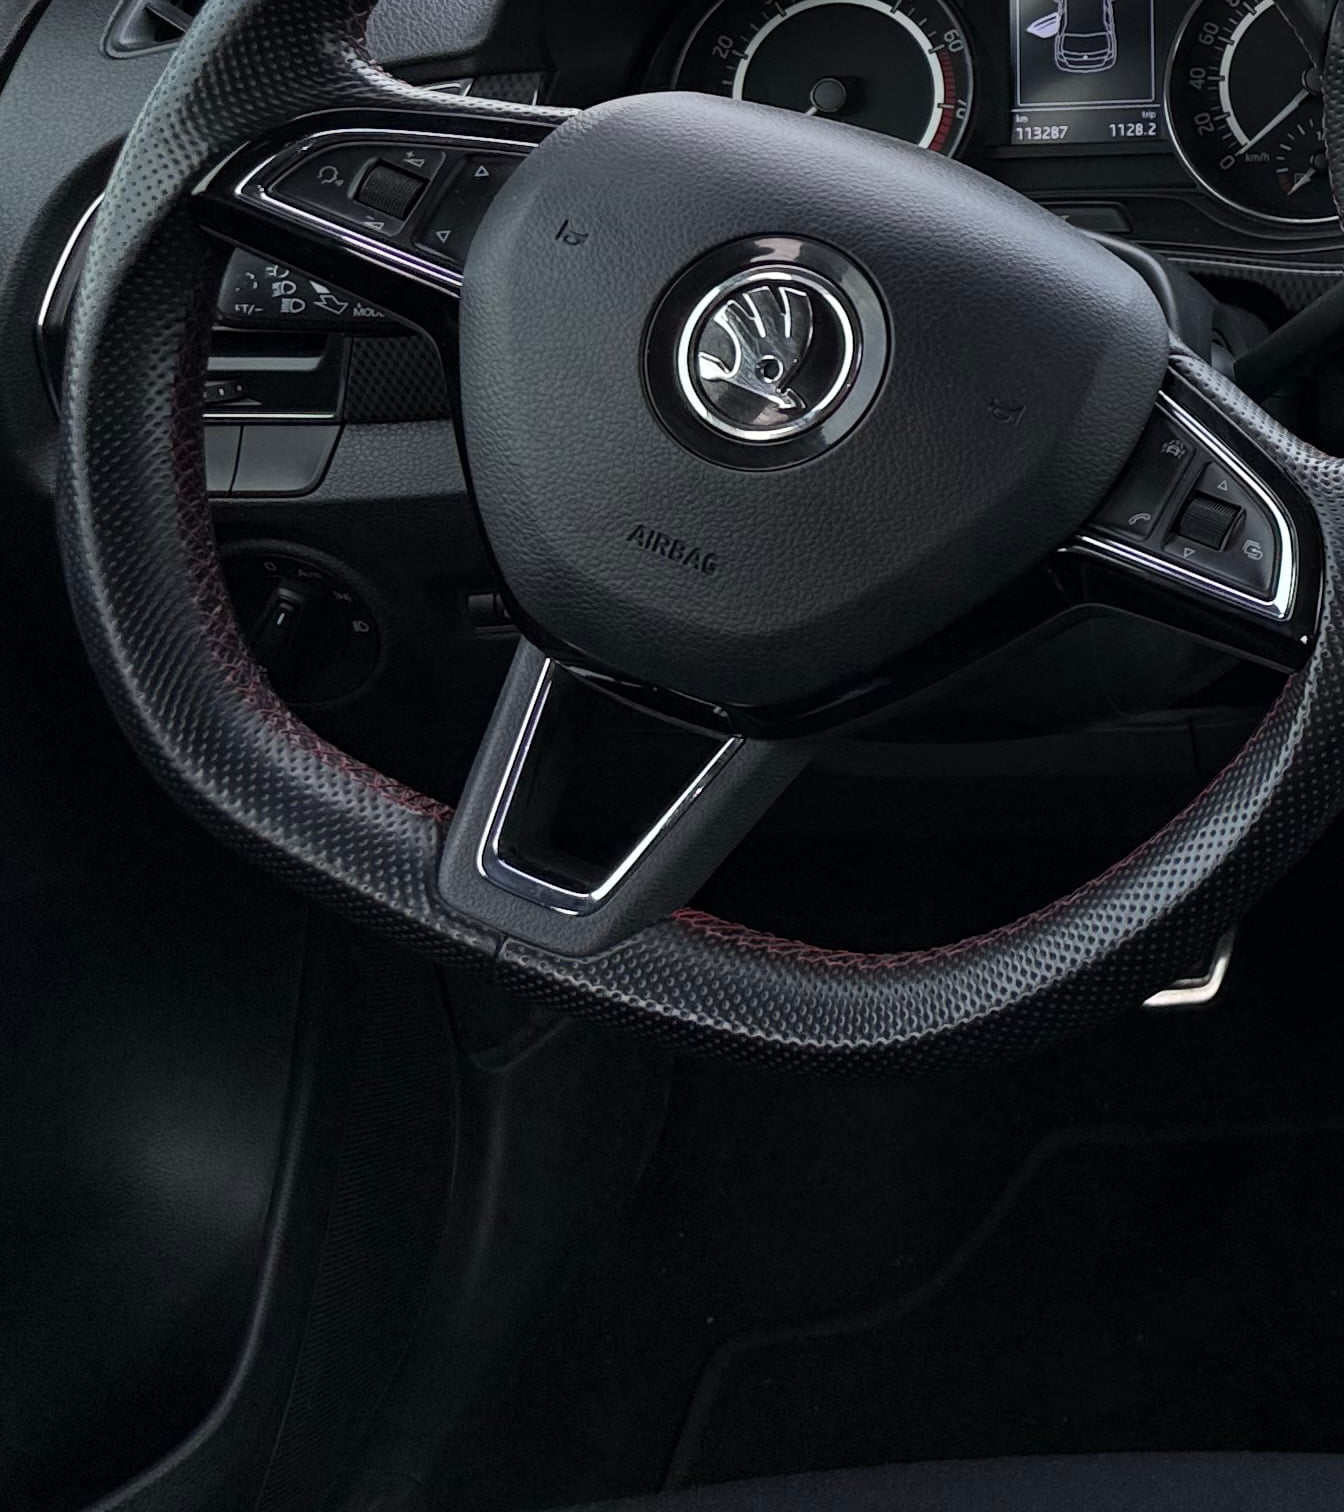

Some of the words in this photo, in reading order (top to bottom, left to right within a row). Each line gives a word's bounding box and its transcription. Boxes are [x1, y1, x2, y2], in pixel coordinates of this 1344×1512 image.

[944, 28, 964, 53] 60
[1198, 21, 1219, 45] 60
[712, 35, 734, 59] 20
[1189, 67, 1206, 89] 40
[1015, 114, 1029, 123] km
[1141, 111, 1156, 120] trip
[1194, 112, 1215, 135] 20
[1016, 125, 1069, 140] 113287
[1109, 122, 1157, 137] 1128.2
[1245, 151, 1270, 164] km/h
[626, 523, 718, 575] AIRBAG
